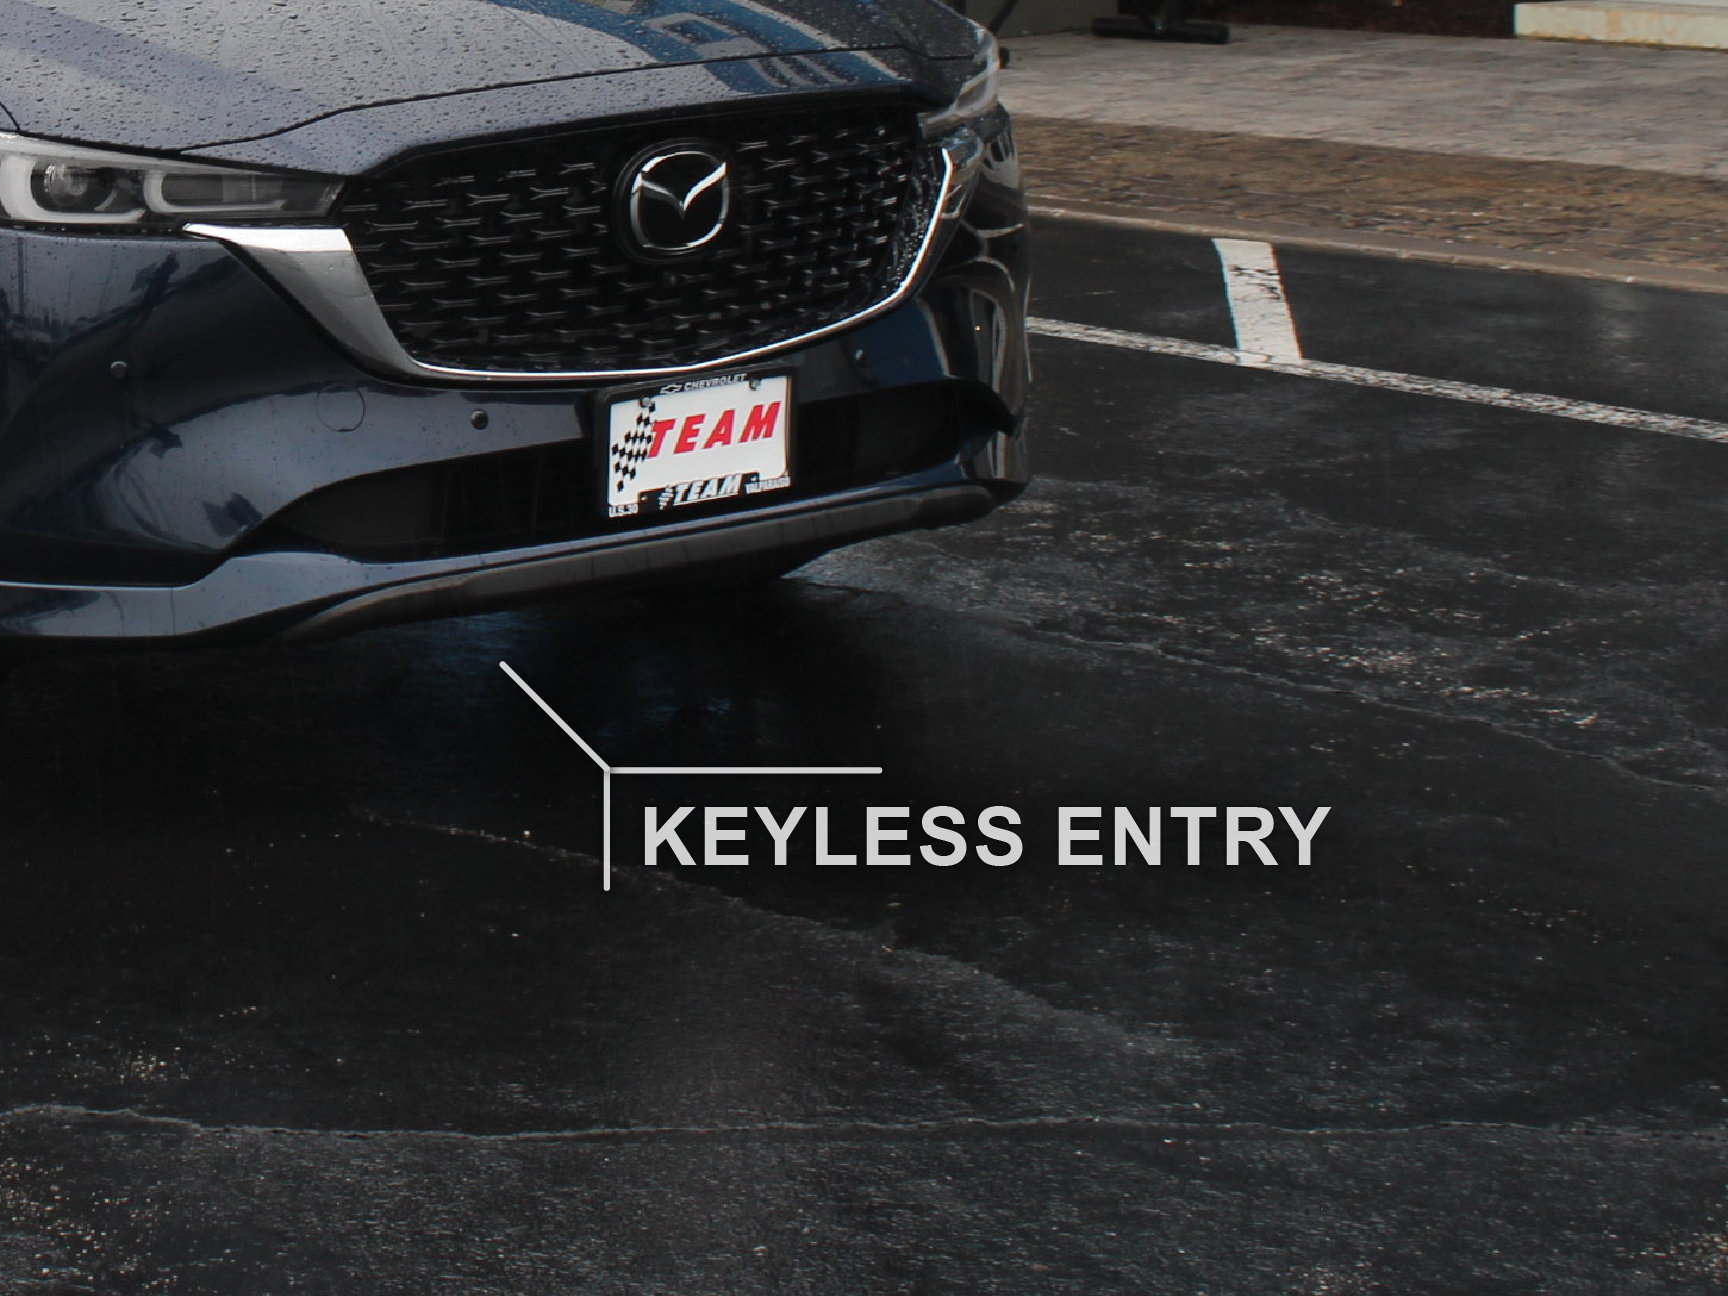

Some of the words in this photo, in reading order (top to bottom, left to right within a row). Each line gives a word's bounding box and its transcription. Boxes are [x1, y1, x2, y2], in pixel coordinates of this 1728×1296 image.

[684, 373, 748, 392] CHEVROLET
[647, 400, 782, 458] TEAM
[672, 474, 744, 506] TEAM
